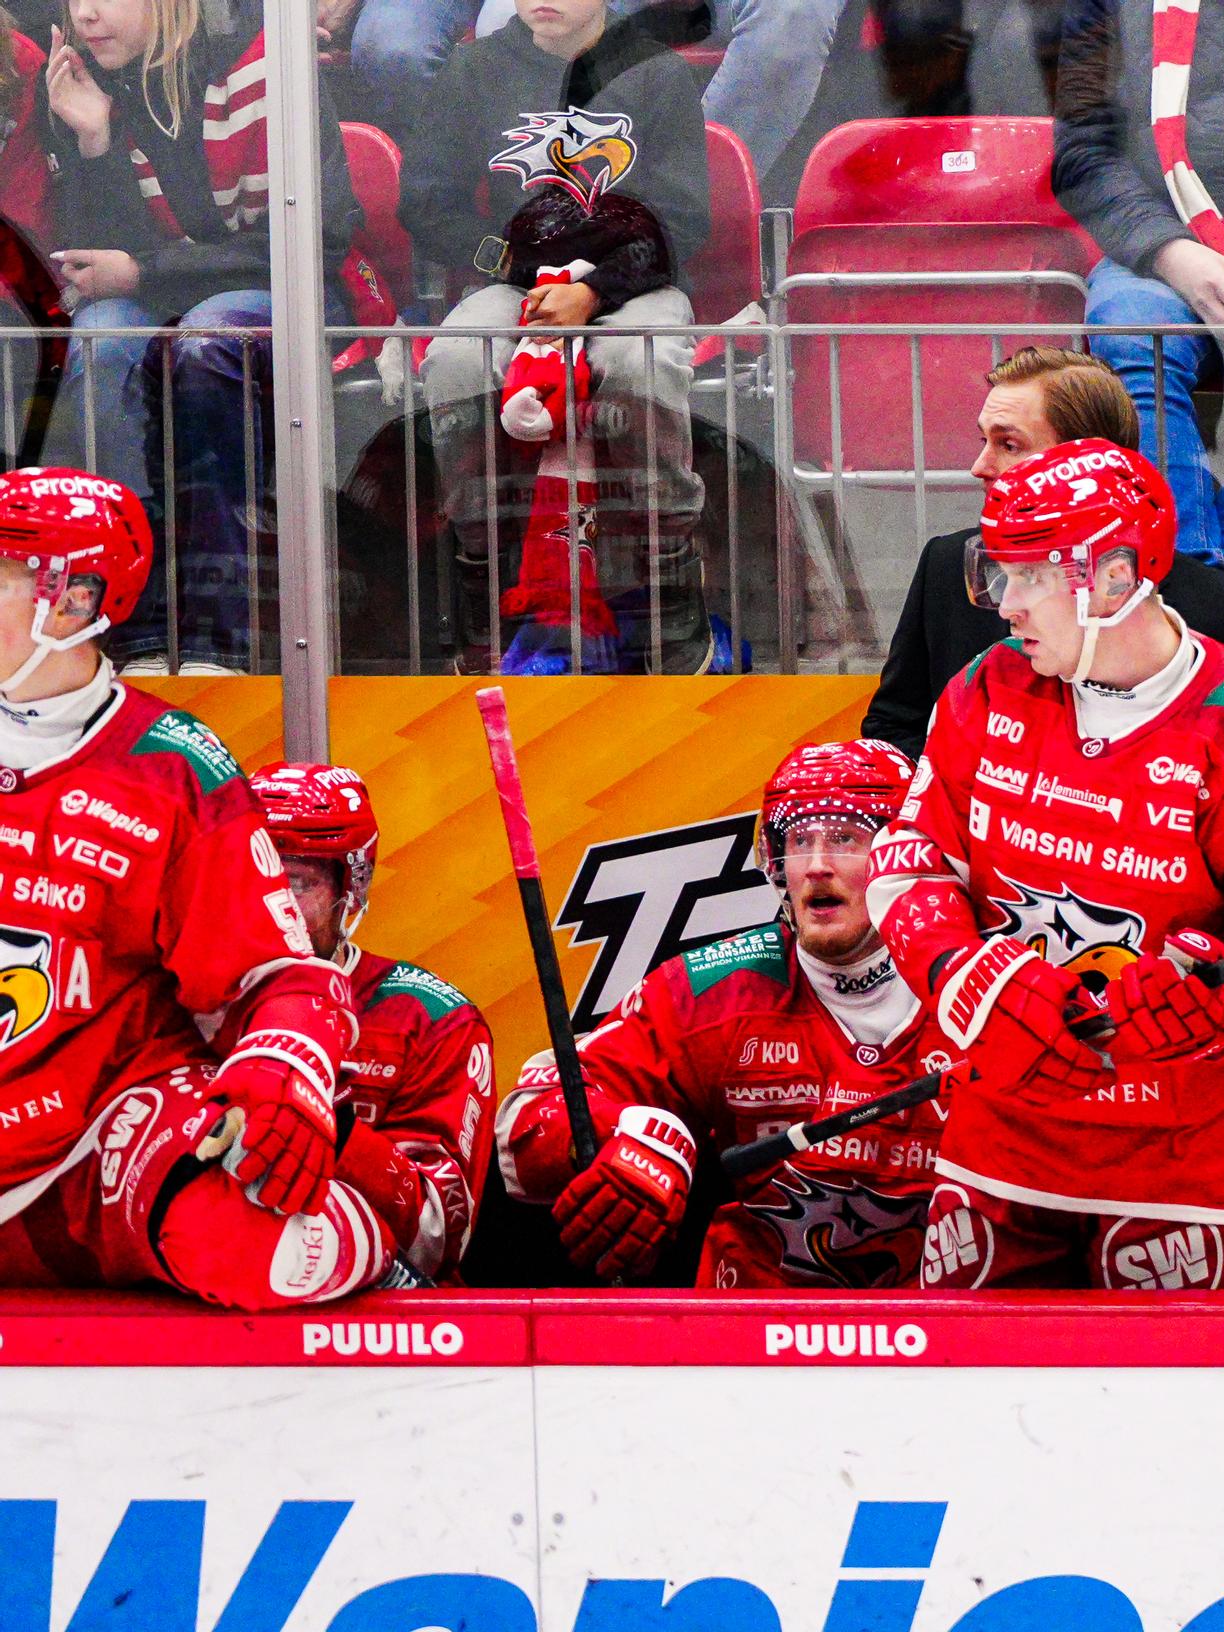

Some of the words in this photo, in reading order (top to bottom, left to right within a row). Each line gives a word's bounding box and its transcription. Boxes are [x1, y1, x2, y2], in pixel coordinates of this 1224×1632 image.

[948, 156, 969, 167] 304
[30, 476, 122, 501] Prohoc
[1026, 449, 1122, 495] Prohoc
[986, 711, 1025, 744] KPO
[85, 798, 160, 843] Wapice
[1146, 802, 1194, 832] VE
[53, 833, 130, 879] VEO
[875, 841, 936, 873] VKK
[1000, 817, 1093, 866] VAASAN
[1101, 846, 1187, 884] SÄHKÖ
[66, 945, 92, 1010] A
[762, 1041, 799, 1064] KPO
[724, 1083, 820, 1101] HARTMAN
[303, 1323, 464, 1357] PUUILO
[765, 1324, 928, 1358] PUUILO
